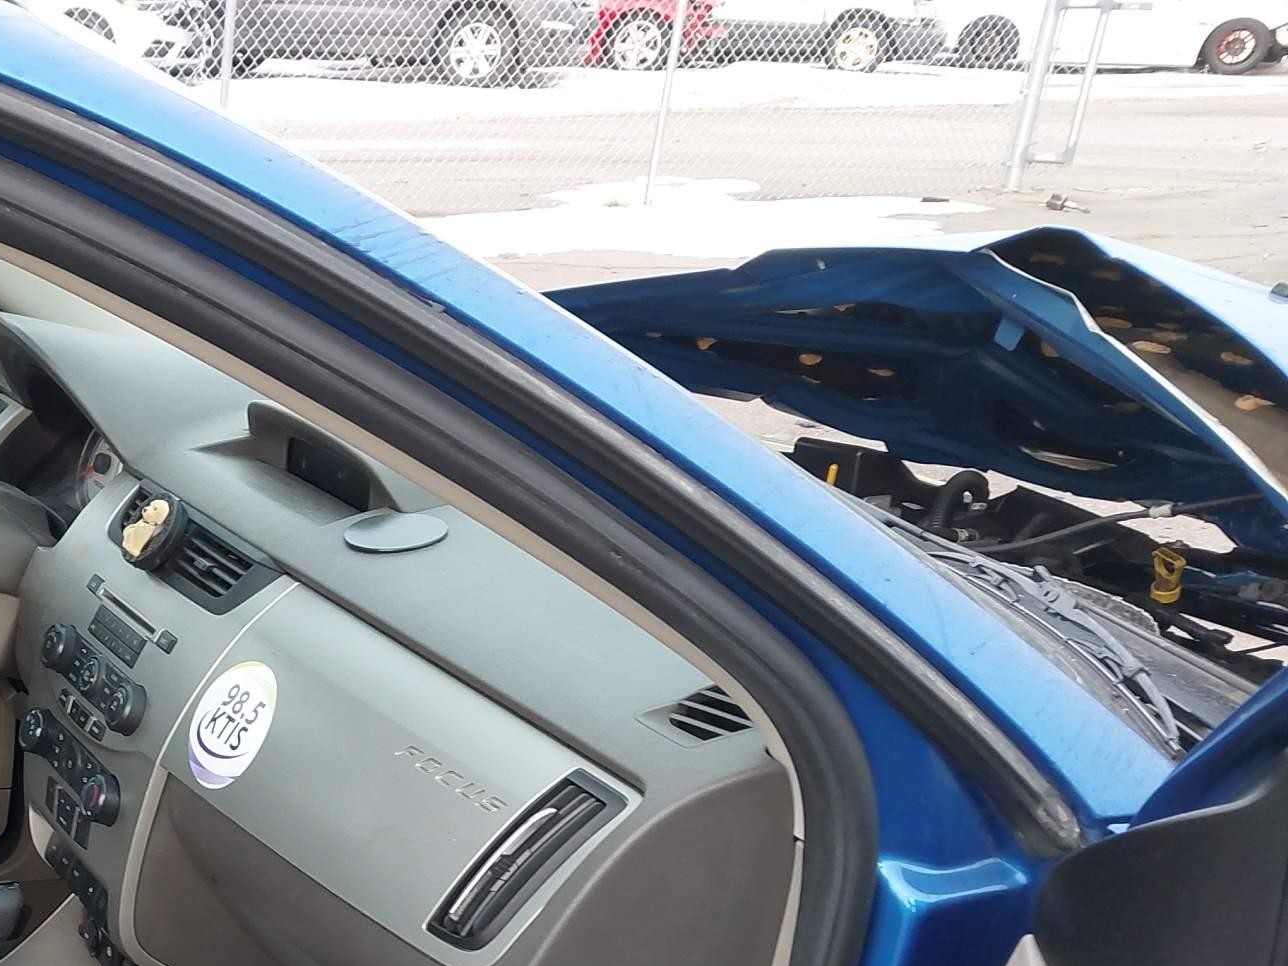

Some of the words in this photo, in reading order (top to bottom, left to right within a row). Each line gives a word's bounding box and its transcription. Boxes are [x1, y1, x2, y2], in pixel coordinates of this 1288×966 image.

[221, 683, 266, 725] 98.5
[205, 706, 248, 751] KTIS
[394, 745, 508, 812] FOCUS
